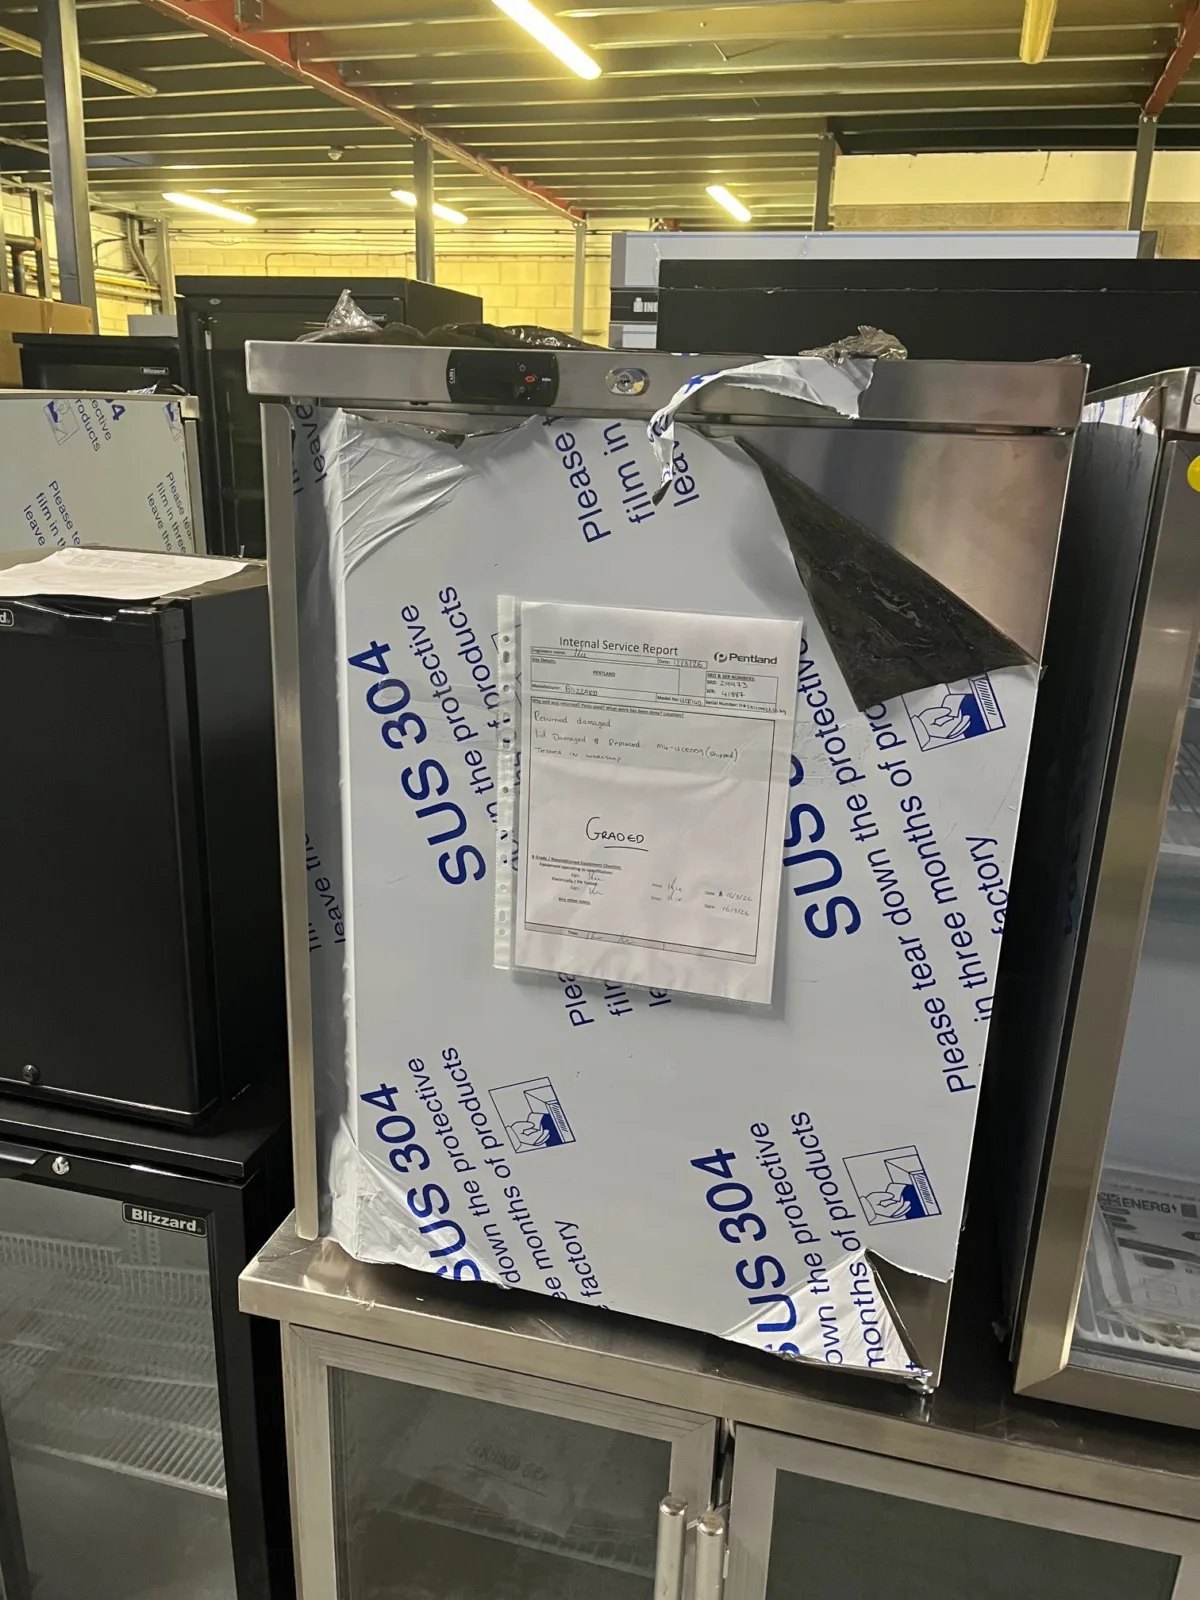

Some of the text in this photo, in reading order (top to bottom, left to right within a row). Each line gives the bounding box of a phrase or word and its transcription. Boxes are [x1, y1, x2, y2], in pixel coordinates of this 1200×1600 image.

[75, 398, 100, 452] roducts
[89, 398, 112, 441] ective
[157, 482, 169, 506] film
[166, 506, 174, 521] in
[166, 471, 185, 516] Please
[555, 432, 611, 543] Please
[603, 422, 655, 524] film in
[23, 504, 46, 546] leave
[36, 492, 60, 537] film in
[49, 480, 74, 530] Please
[146, 493, 172, 552] leave the
[559, 636, 600, 649] Internal
[602, 640, 640, 653] Service
[642, 643, 678, 656] Report
[729, 652, 778, 665] Pentland
[401, 605, 494, 794] the protective
[534, 710, 611, 729] Returned damaged
[348, 641, 486, 885] SUS 304
[552, 733, 586, 744] Damaged
[609, 738, 640, 748] Replaced
[877, 760, 912, 787] of
[846, 793, 879, 842] the
[783, 803, 861, 938] SUS
[900, 795, 957, 904] months
[314, 877, 346, 943] leave
[867, 848, 912, 926] down
[898, 935, 936, 990] tear
[944, 911, 987, 989] three
[974, 996, 994, 1022] in
[924, 997, 976, 1093] Please
[360, 1083, 430, 1173] 304
[408, 1058, 521, 1284] down the protective
[442, 1047, 553, 1270] months of products
[791, 1111, 856, 1221] products
[131, 1208, 197, 1232] Blizzard
[690, 1148, 767, 1243] 304
[1123, 1197, 1171, 1213] ENERG
[555, 1220, 602, 1298] factory
[750, 1122, 843, 1364] own the protective
[830, 1229, 861, 1252] of
